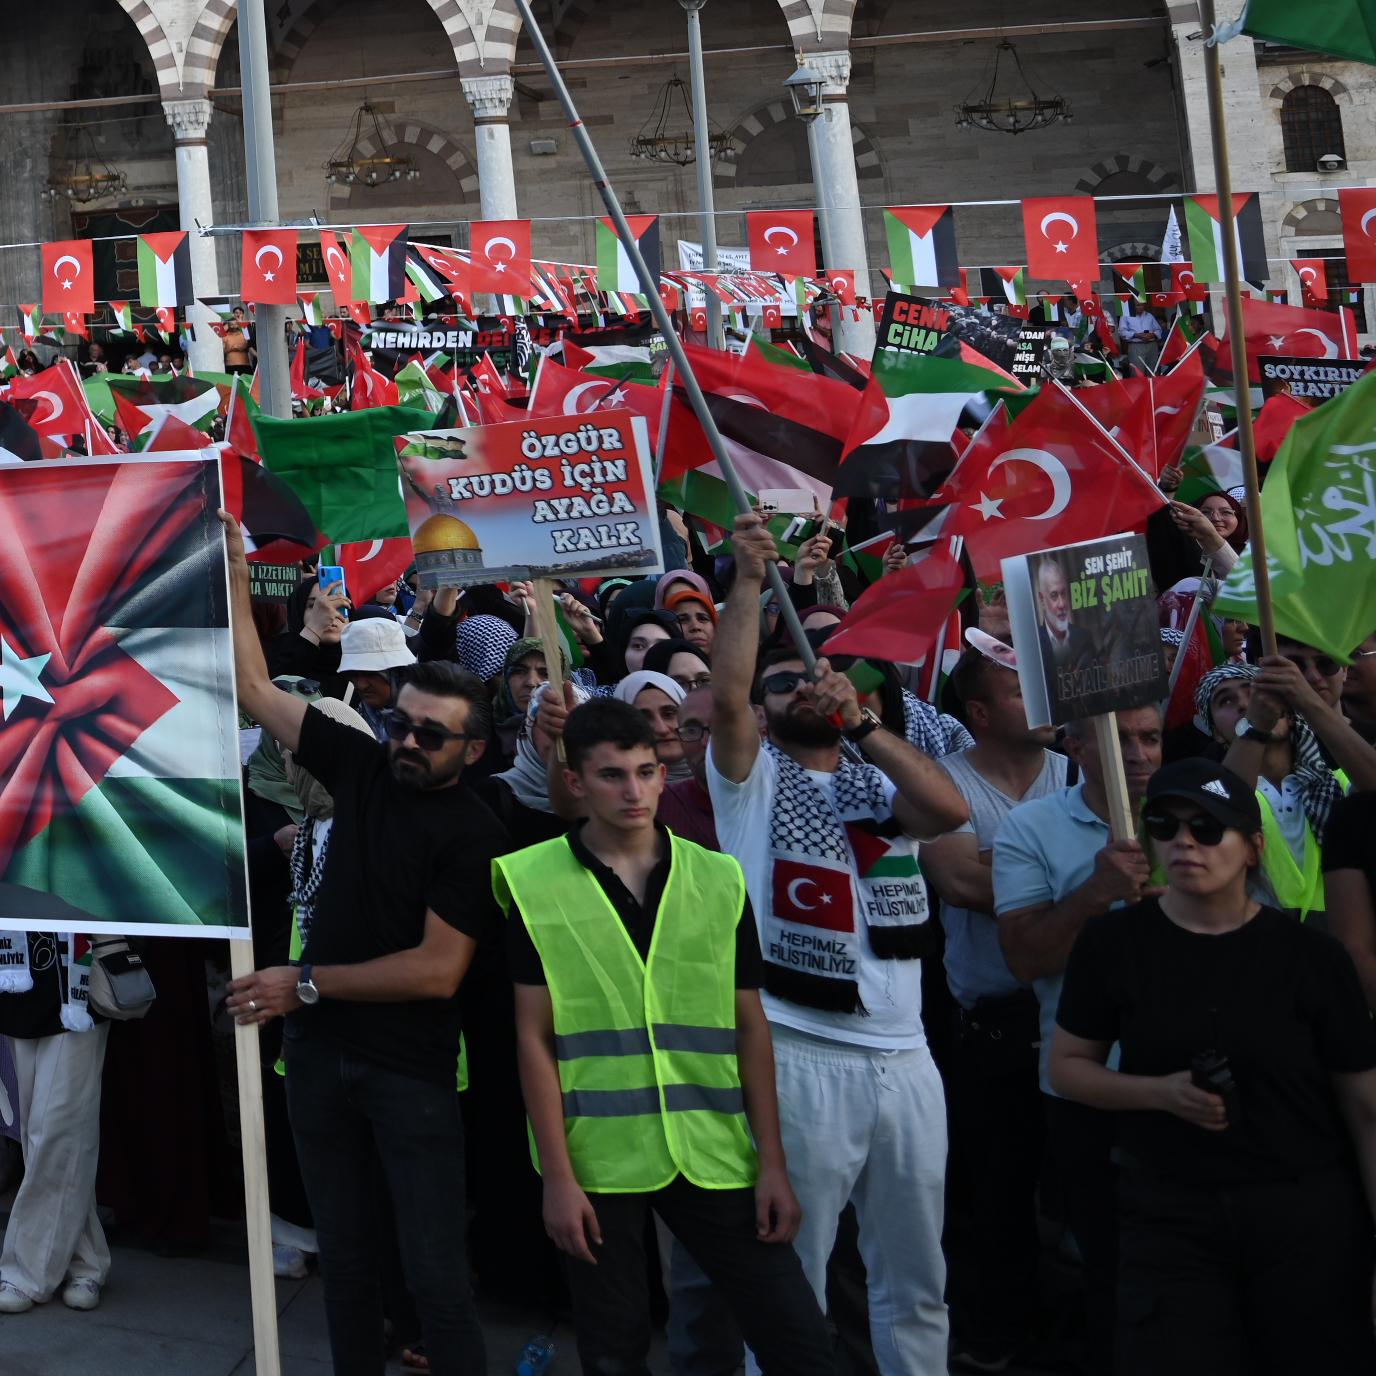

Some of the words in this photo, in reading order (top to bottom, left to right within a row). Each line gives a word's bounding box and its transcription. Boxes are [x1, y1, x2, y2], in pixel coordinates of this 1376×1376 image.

[887, 324, 948, 352] CİHA
[1012, 364, 1041, 373] SELAM
[1264, 363, 1364, 382] SOYKIRIM
[1289, 381, 1351, 398] HAYI
[521, 424, 623, 460] ÖZGÜR
[448, 464, 552, 500] KUDÜS
[561, 455, 627, 492] İÇİN
[532, 487, 636, 523] AYAĞA
[551, 522, 642, 553] KALK
[1085, 555, 1104, 575] SEN
[1106, 546, 1132, 576] ŞEHİT
[1070, 571, 1098, 610] BİZ
[1101, 561, 1148, 612] ŞAHİT
[780, 929, 849, 955] HEPİMİZ
[770, 942, 856, 974] FİLİSTİNLİYİZ
